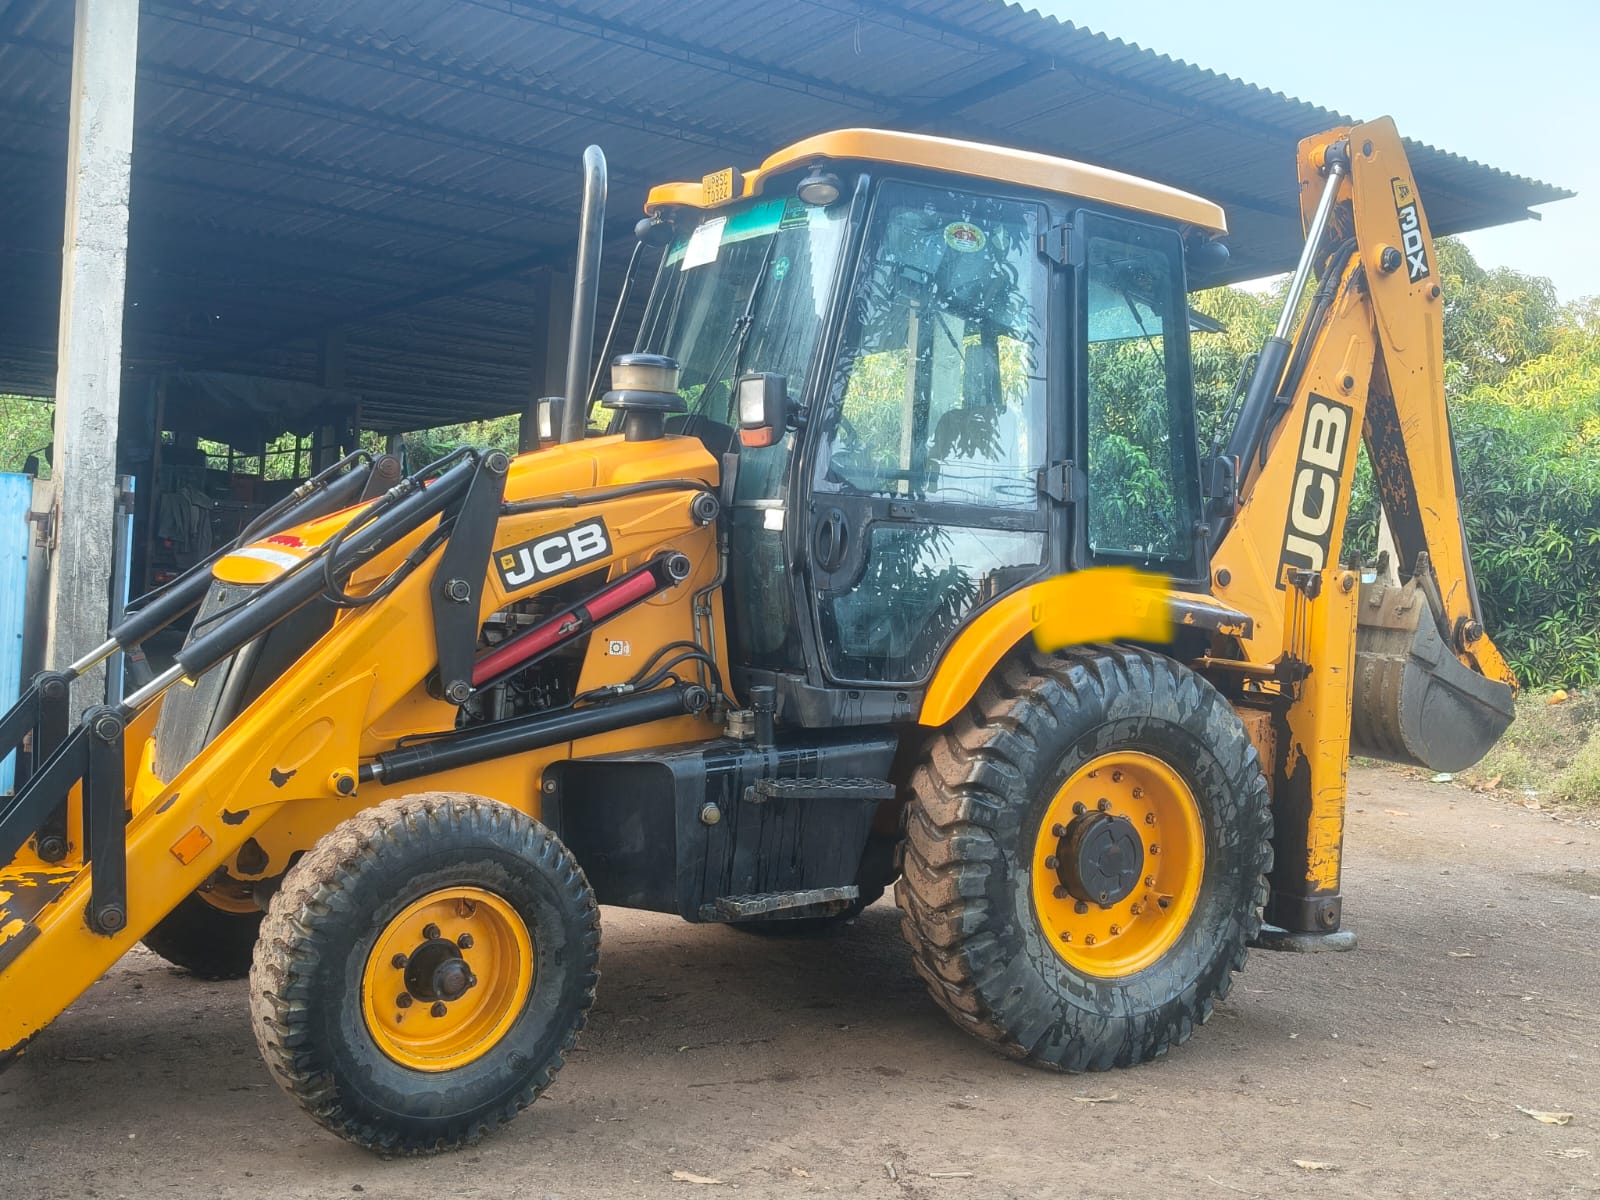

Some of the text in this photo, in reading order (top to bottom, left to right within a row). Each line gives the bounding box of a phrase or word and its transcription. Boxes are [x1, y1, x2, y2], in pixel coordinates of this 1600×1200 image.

[1399, 206, 1428, 278] 3DX
[1285, 402, 1347, 572] JCB
[505, 523, 607, 585] JCB
